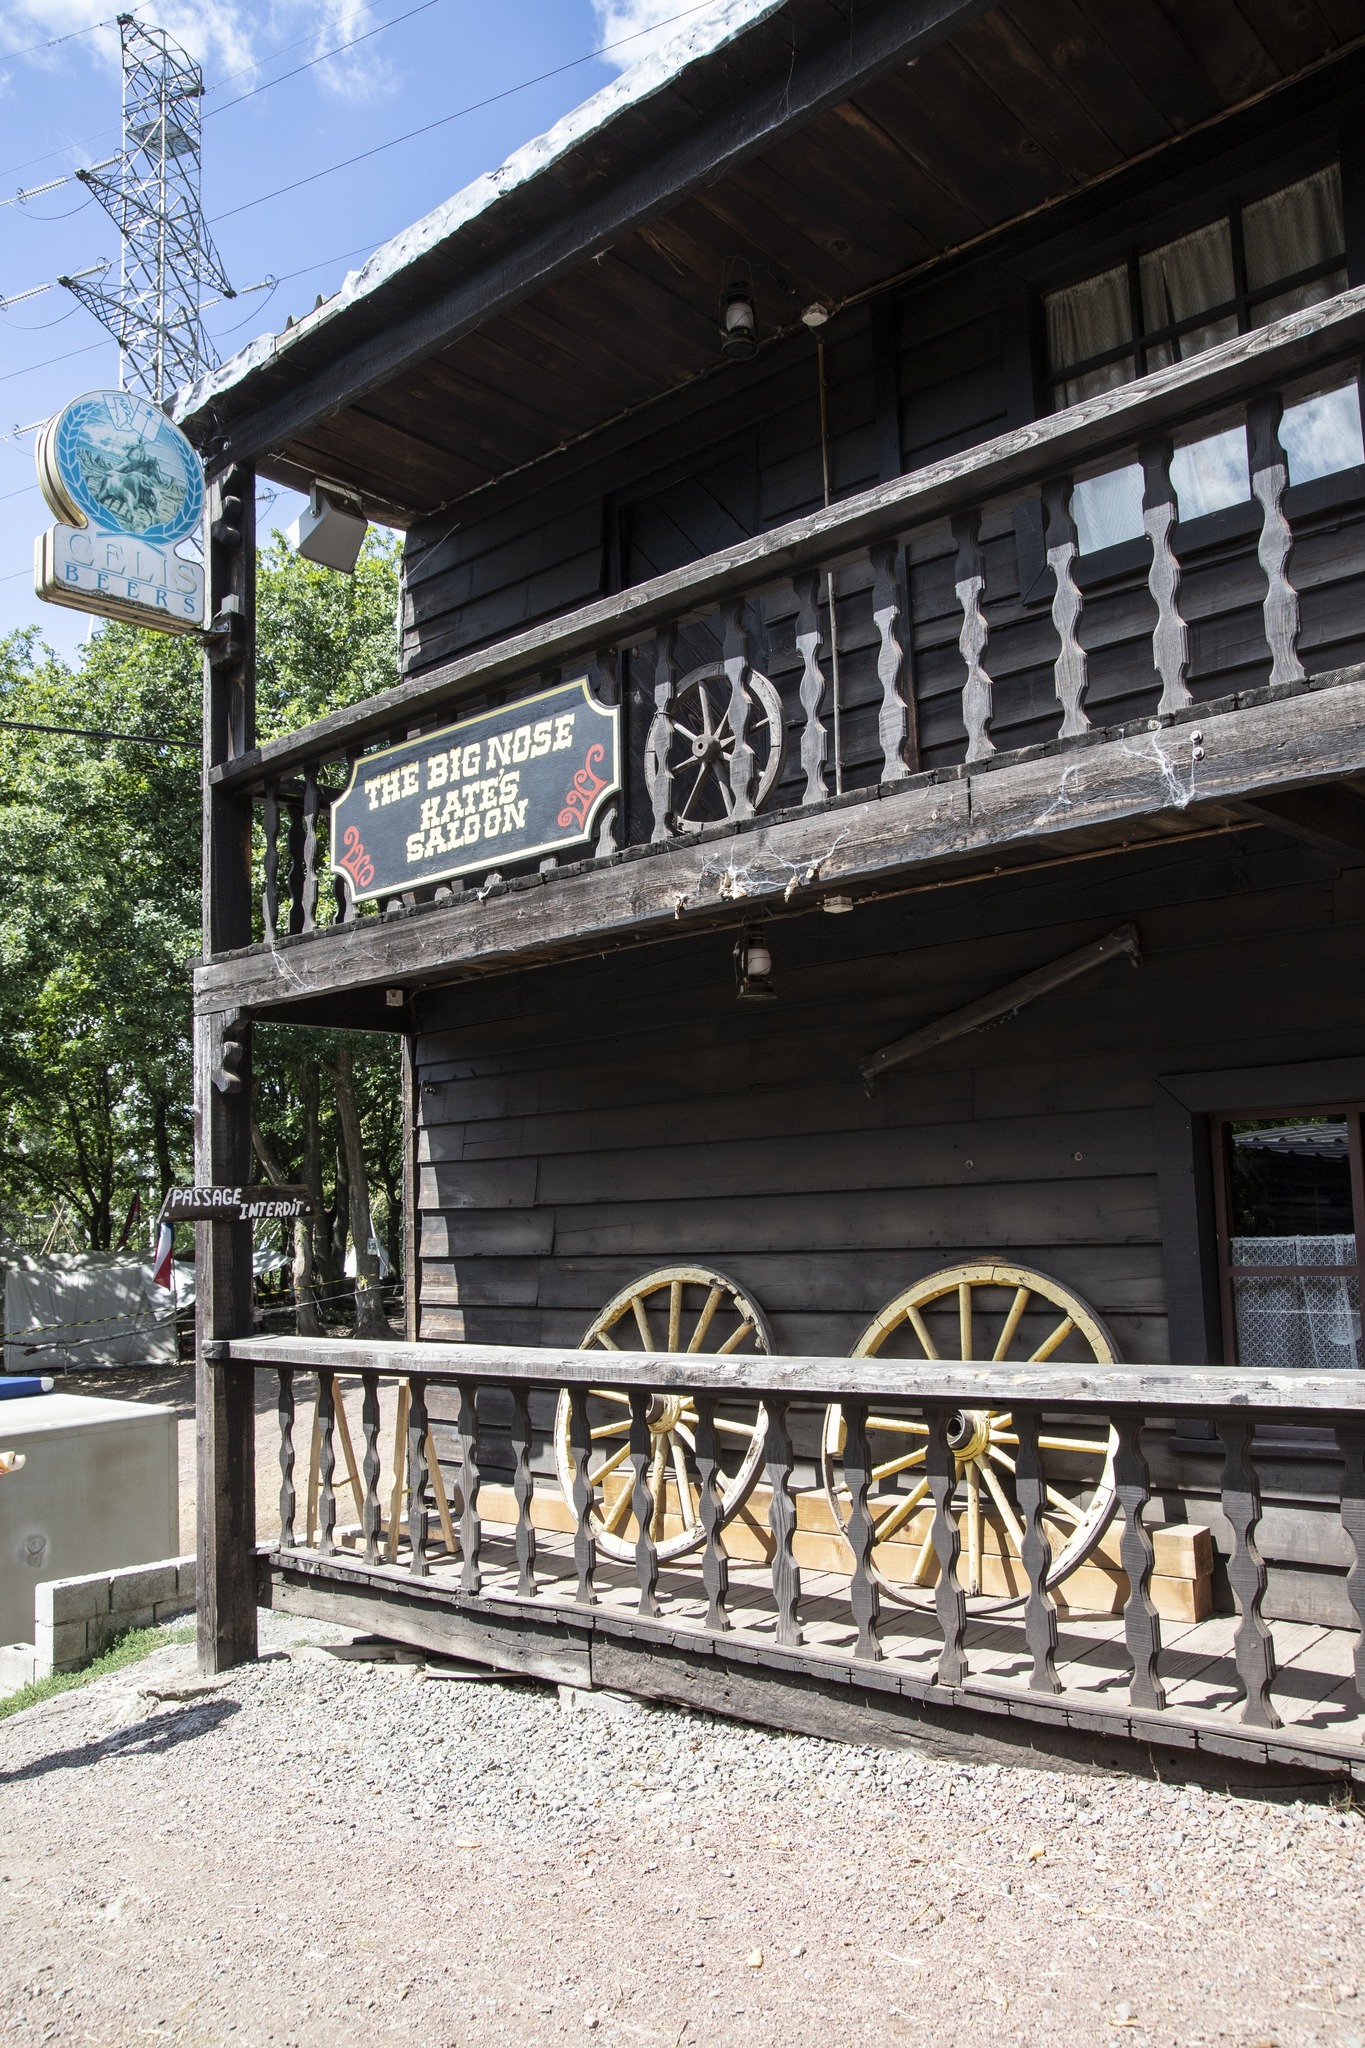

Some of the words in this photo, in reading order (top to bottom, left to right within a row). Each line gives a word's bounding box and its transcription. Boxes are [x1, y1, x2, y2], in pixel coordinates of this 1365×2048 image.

[65, 565, 195, 613] BEERS
[70, 534, 197, 595] CELIS
[364, 760, 420, 811] THE
[426, 742, 481, 790] BIG
[485, 713, 576, 771] NOSE
[406, 798, 529, 863] SALOON
[420, 768, 520, 831] KATE'S
[171, 1188, 242, 1208] PASSAGE
